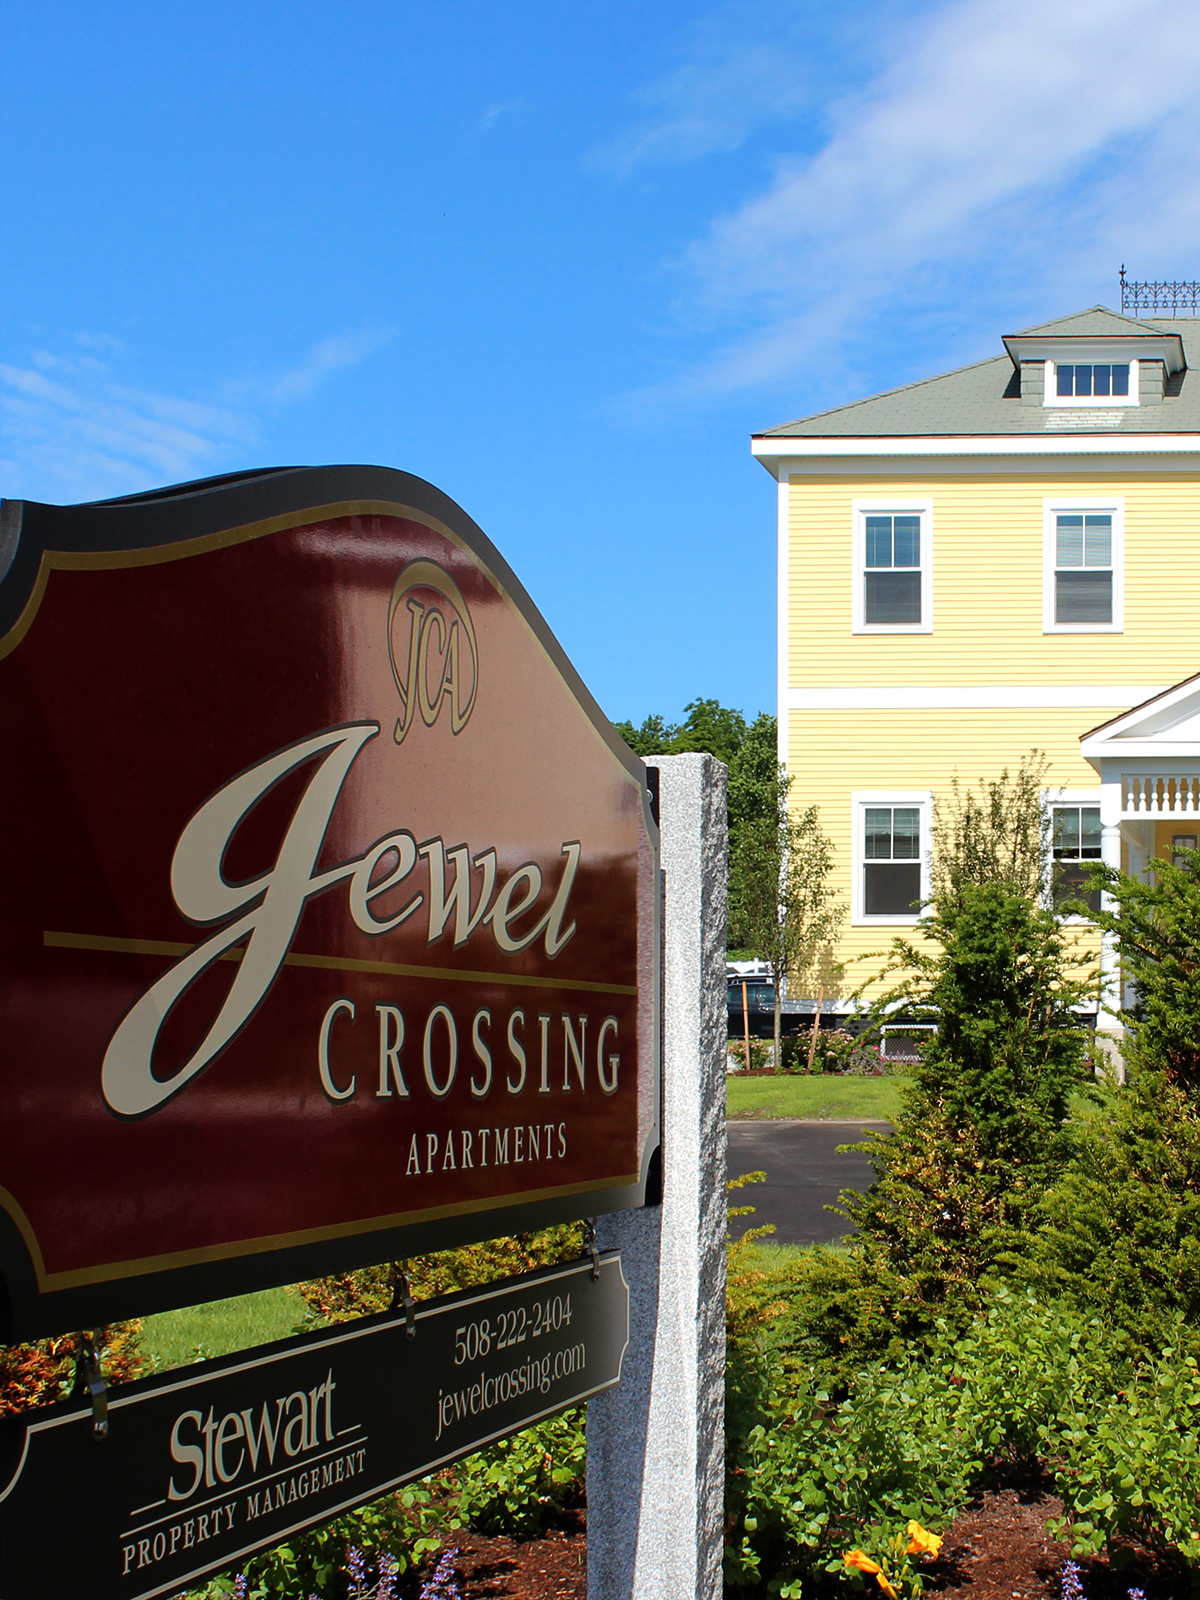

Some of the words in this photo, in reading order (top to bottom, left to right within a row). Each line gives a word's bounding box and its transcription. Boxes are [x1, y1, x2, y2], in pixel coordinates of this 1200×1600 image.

[393, 597, 466, 745] JCA
[317, 997, 621, 1104] CROSSING
[405, 1122, 568, 1177] APARTMENTS
[454, 1292, 573, 1366] 508-222-2404
[166, 1368, 337, 1503] Stewart
[434, 1339, 586, 1441] jewelcrossing.com
[121, 1501, 238, 1575] PROPERTY
[246, 1448, 367, 1517] MANAGEMENT
